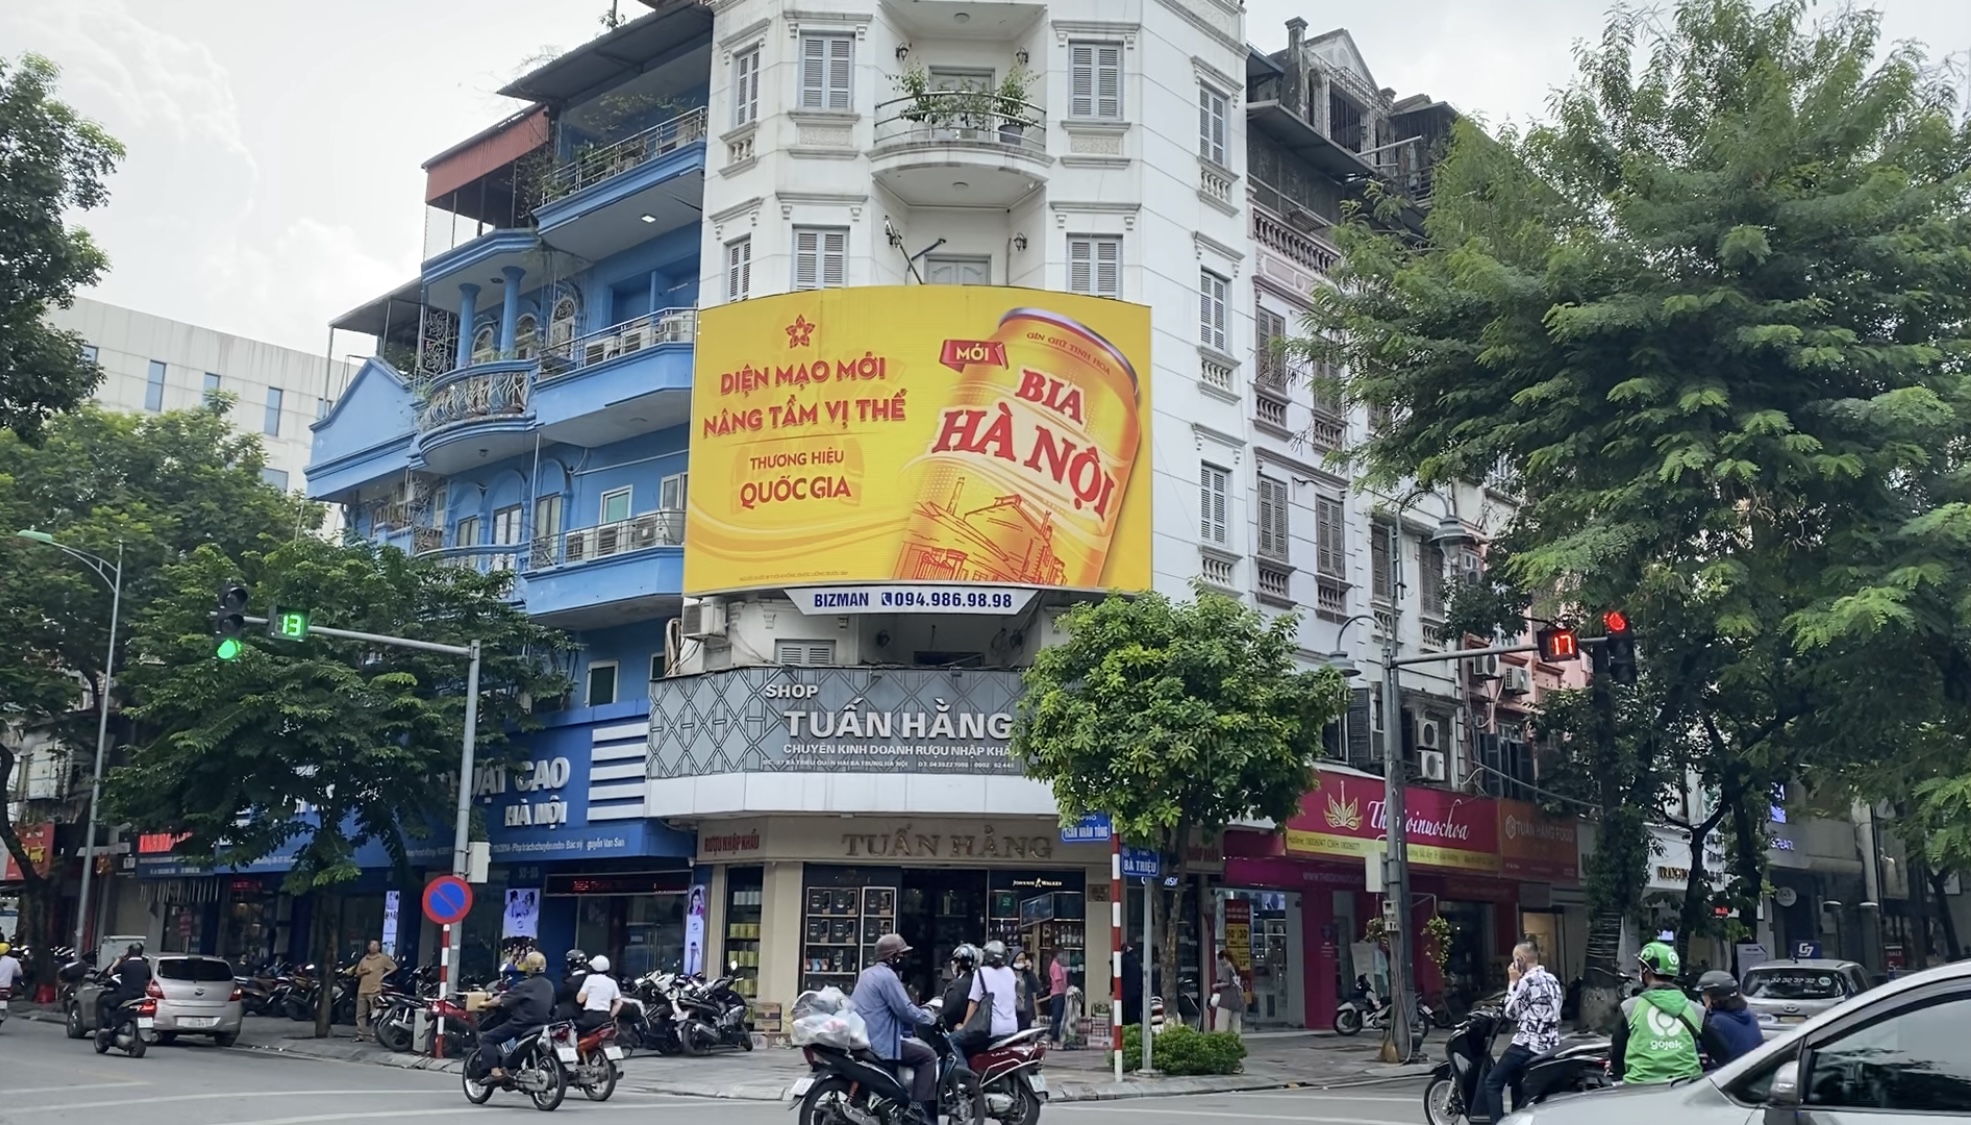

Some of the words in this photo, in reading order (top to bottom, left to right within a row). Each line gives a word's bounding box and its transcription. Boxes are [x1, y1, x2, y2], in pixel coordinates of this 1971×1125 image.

[956, 343, 989, 361] MỚI
[720, 363, 769, 397] DIỆN
[775, 360, 830, 391] MẠO
[1015, 368, 1083, 425] BIA
[703, 408, 763, 439] NÂNG
[769, 394, 818, 428] TẦM
[825, 400, 849, 429] VỊ
[856, 388, 908, 422] THẾ
[750, 452, 807, 470] THƯƠNG
[811, 446, 844, 465] HIỆU
[931, 401, 1017, 462] HÀ
[1023, 425, 1115, 522] NỘI
[740, 475, 807, 509] QUỐC
[810, 475, 852, 499] GIA
[814, 592, 869, 607] BIZMAN
[894, 592, 1012, 608] 094.986.98.98
[282, 614, 301, 636] 13
[1554, 635, 1573, 655] 17
[765, 684, 819, 699] SHOP
[784, 697, 892, 739] TUẤN
[902, 698, 1013, 739] HẰNG
[783, 743, 836, 755] CHUYÊN
[837, 744, 867, 755] KINH
[870, 745, 914, 756] DOANH
[915, 745, 949, 758] RƯỢU
[951, 743, 984, 758] NHẬP
[514, 756, 570, 791] CAO
[504, 798, 532, 827] HÀ
[534, 795, 567, 829] NỘI
[841, 824, 940, 858] TUẤN
[1136, 859, 1157, 875] TRIỆU
[1650, 1040, 1683, 1051] gojek
